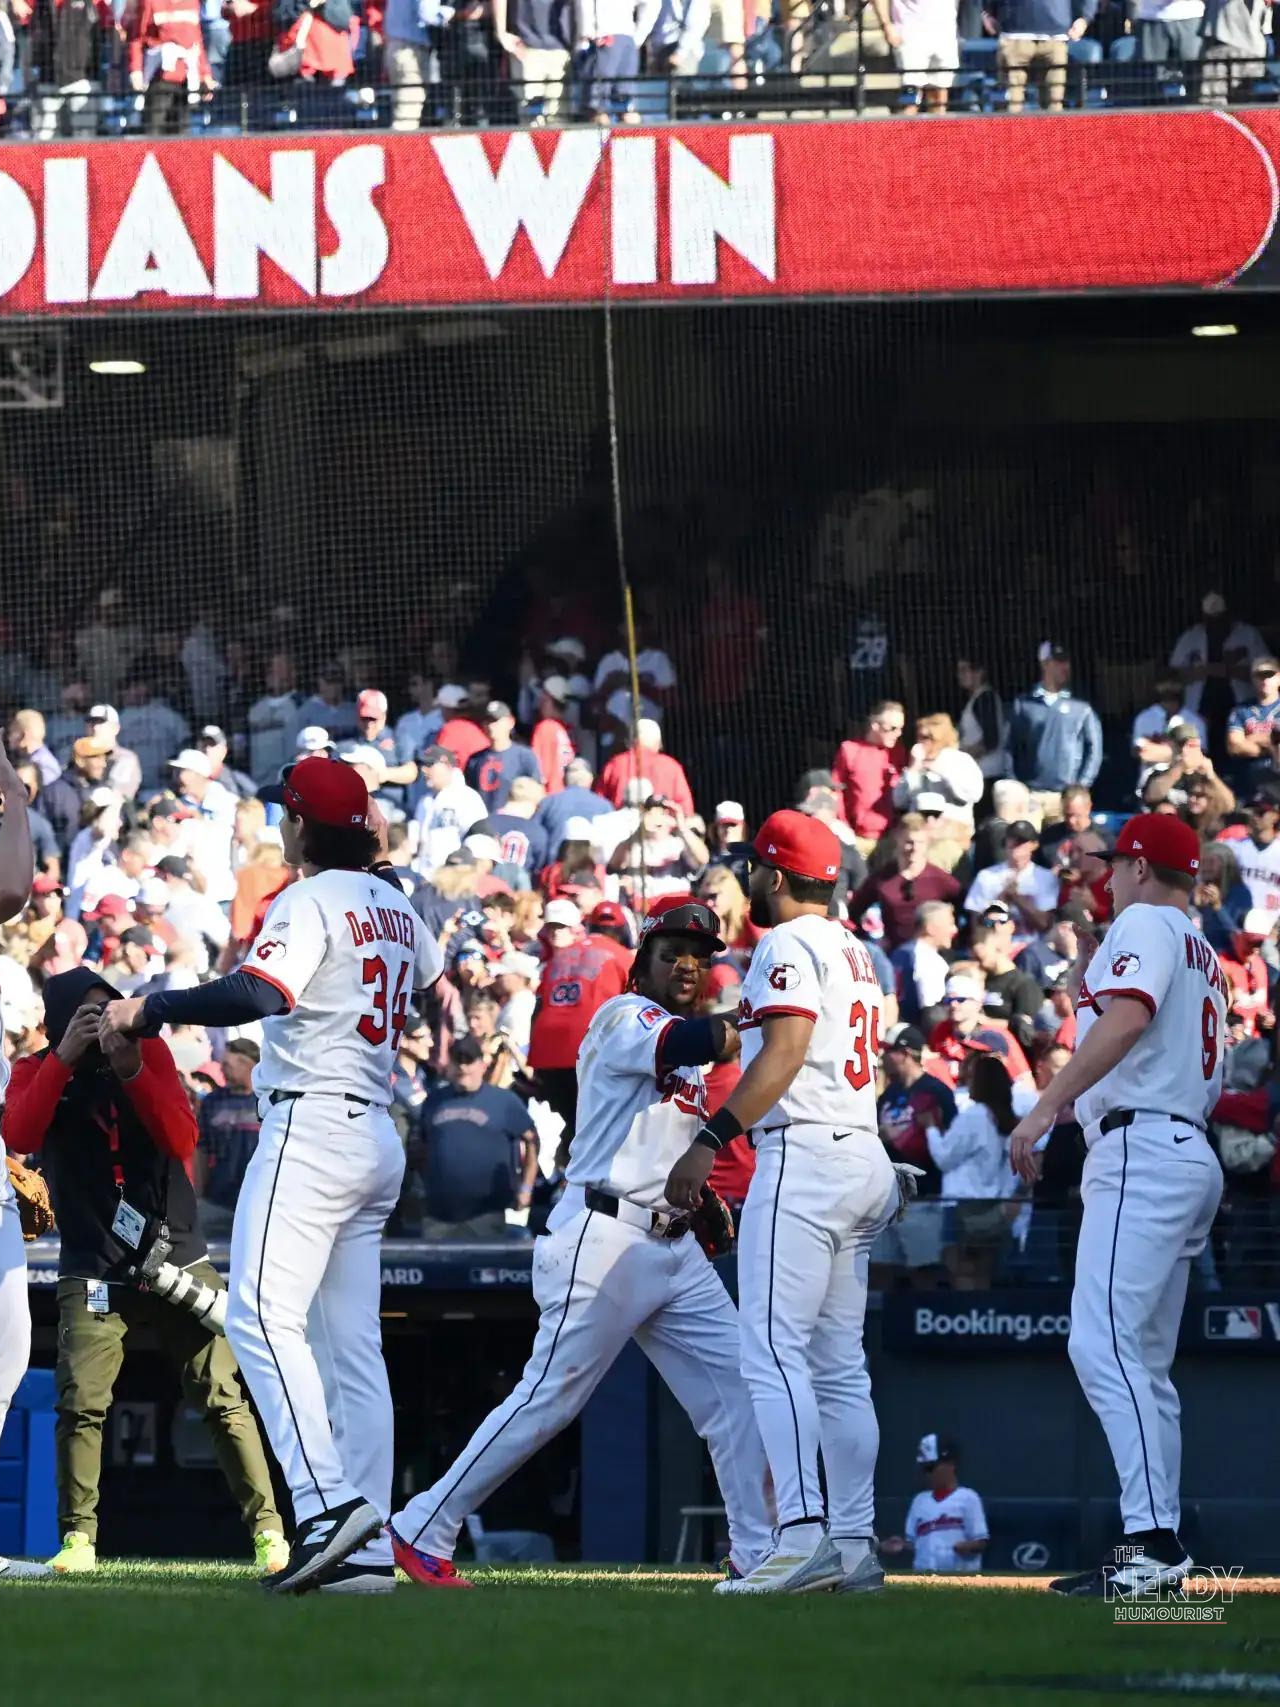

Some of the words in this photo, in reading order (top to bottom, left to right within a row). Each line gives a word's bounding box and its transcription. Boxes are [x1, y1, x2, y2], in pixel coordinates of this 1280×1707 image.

[431, 131, 777, 284] WIN
[356, 954, 410, 1051] 34
[1201, 996, 1218, 1080] 9
